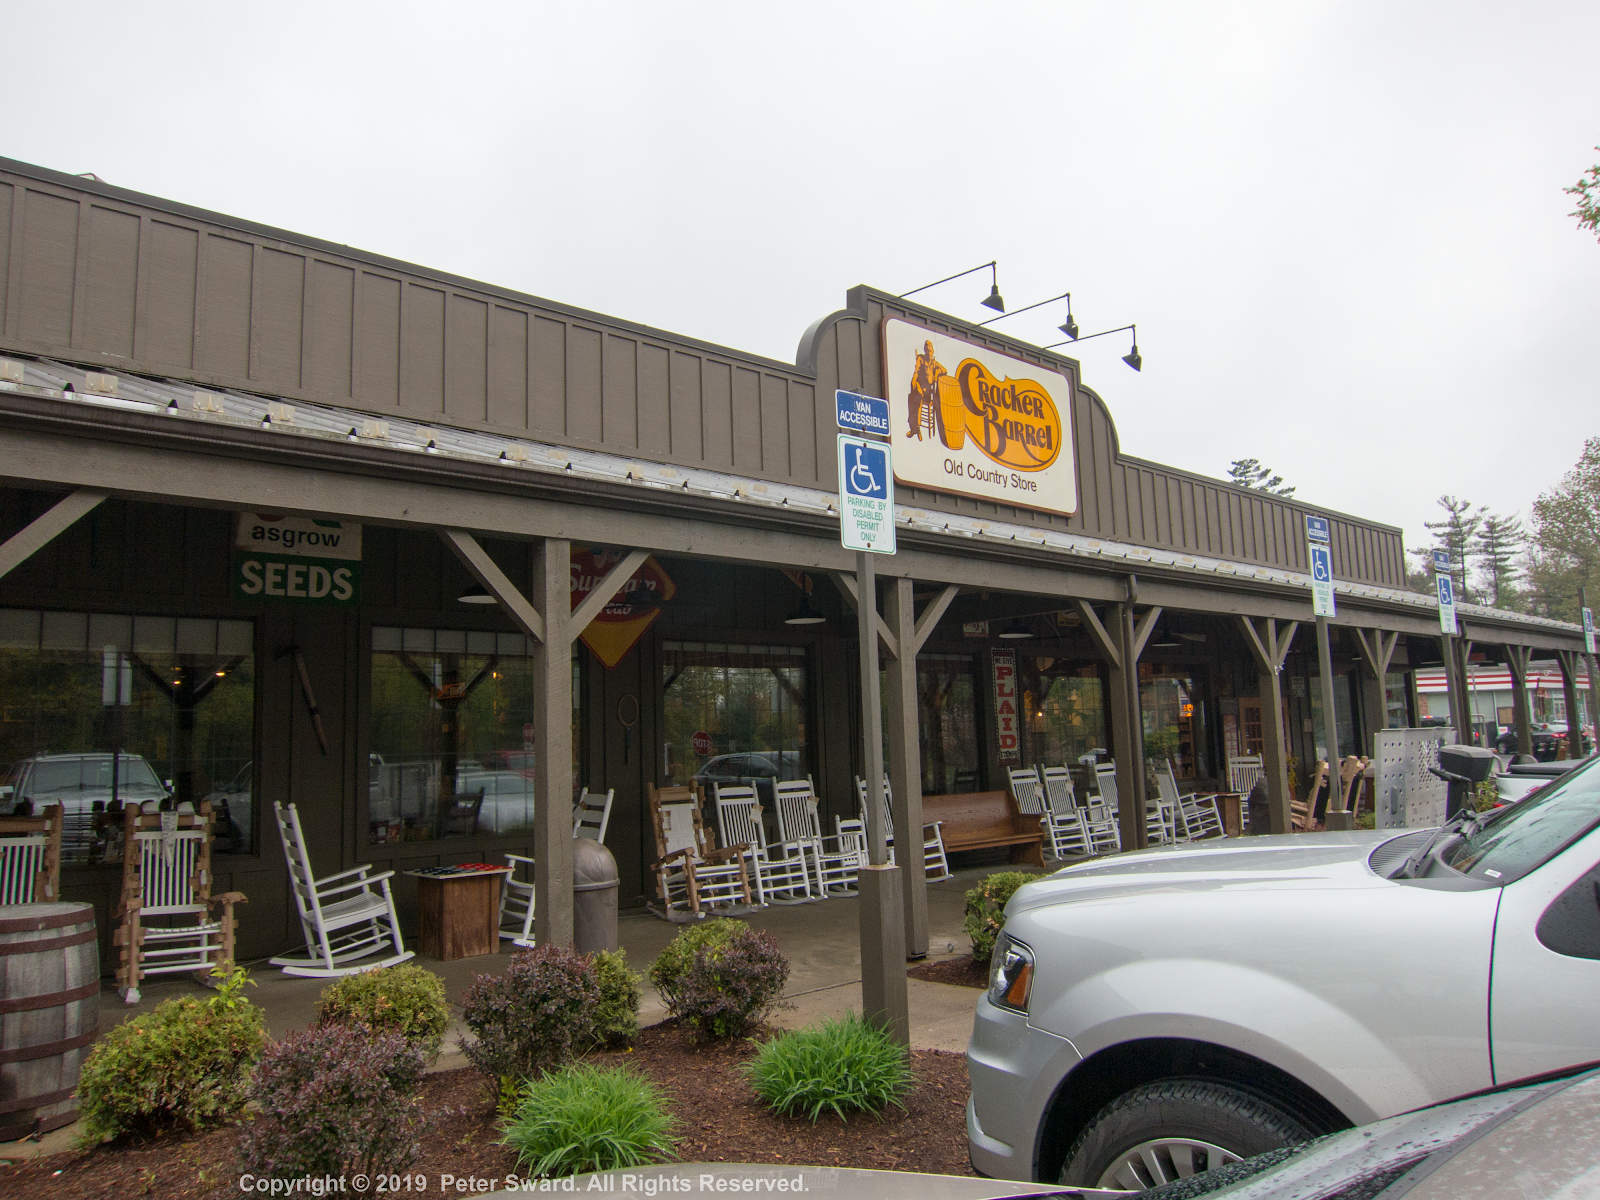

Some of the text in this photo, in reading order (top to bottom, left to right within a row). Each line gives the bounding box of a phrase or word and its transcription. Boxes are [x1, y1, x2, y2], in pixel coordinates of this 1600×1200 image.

[959, 363, 1045, 419] Cracker
[855, 400, 872, 414] VAN
[839, 410, 888, 430] ACCESSIBLE
[983, 403, 1054, 458] Barrel
[943, 458, 1038, 492] Old Country Store
[847, 496, 887, 511] PARKING BY
[852, 508, 883, 521] DISABLED
[856, 519, 880, 532] PERMIT
[251, 525, 341, 548] asgrow
[860, 531, 877, 542] ONLY
[240, 560, 354, 601] SEEDS
[996, 666, 1017, 749] PLAID
